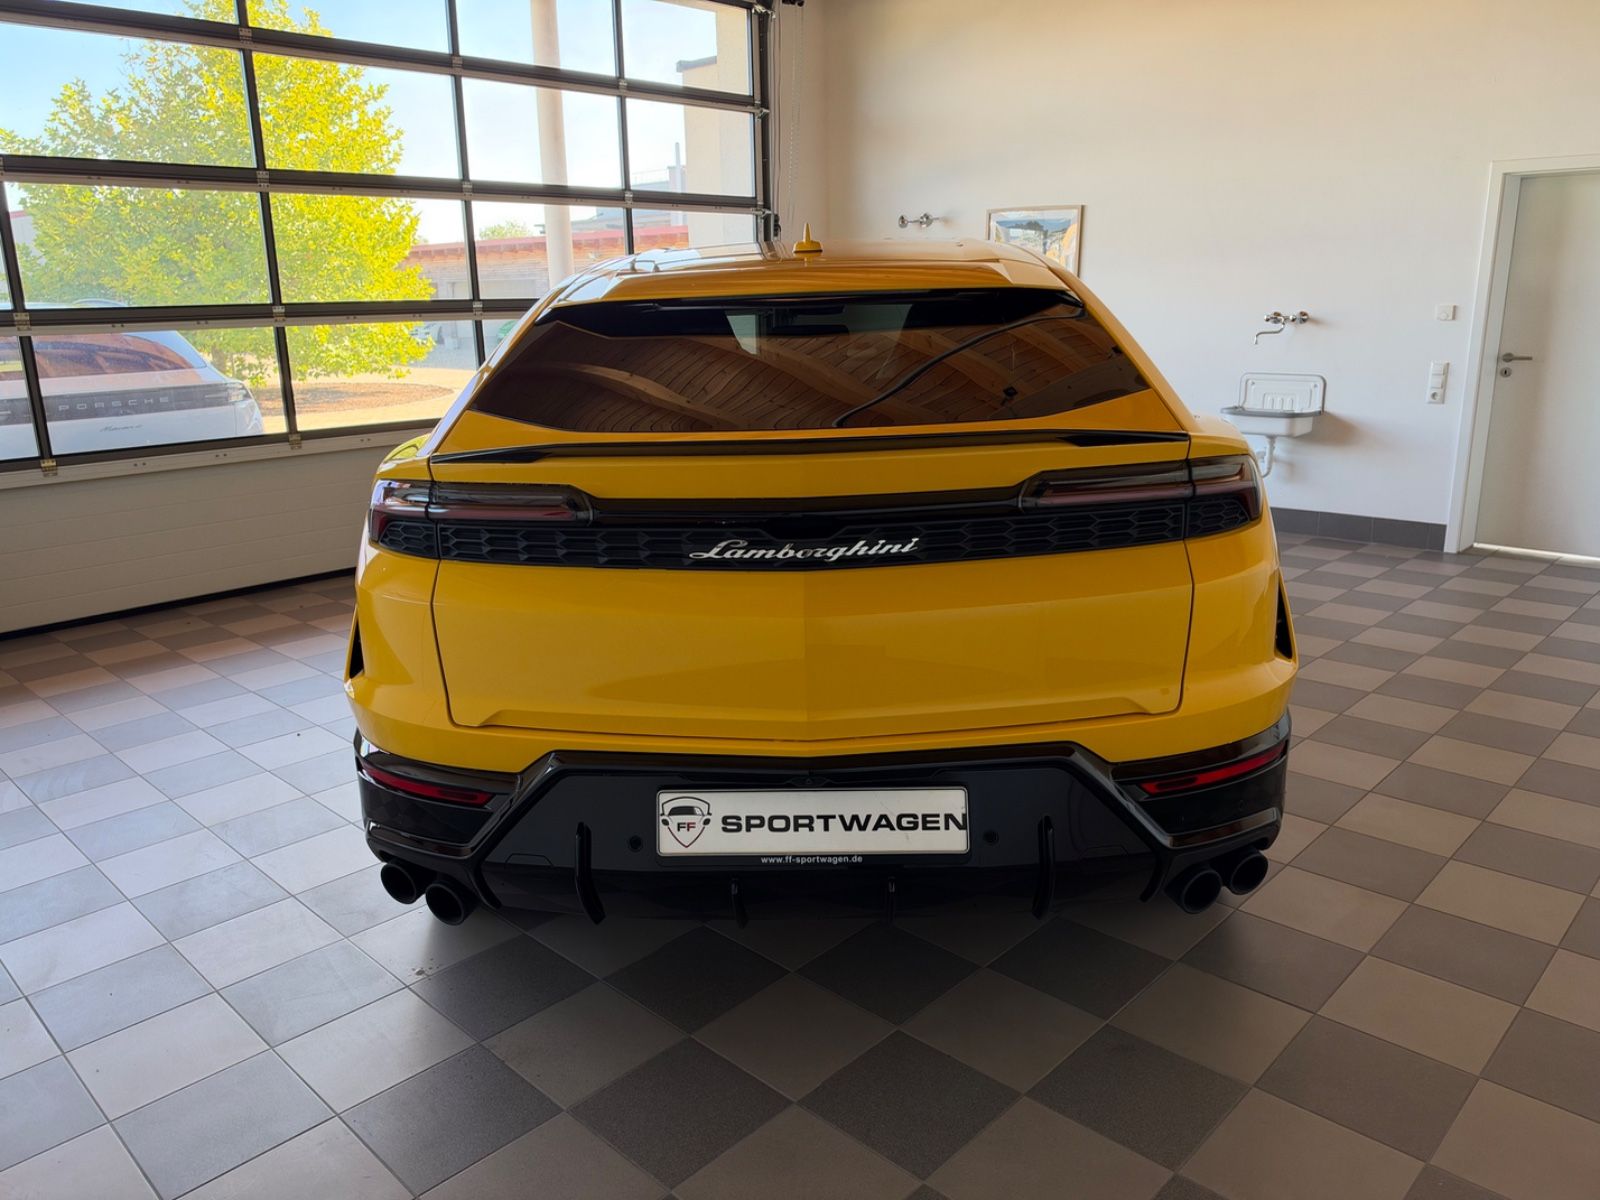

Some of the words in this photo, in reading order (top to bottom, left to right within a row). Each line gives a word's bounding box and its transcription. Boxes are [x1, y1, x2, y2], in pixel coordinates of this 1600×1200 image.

[58, 397, 169, 411] PORSCHE
[688, 538, 920, 562] Lamborghini
[677, 821, 696, 832] FF
[721, 813, 967, 833] SPORTWAGEN
[761, 855, 863, 865] www.ff-sportwagen.de
